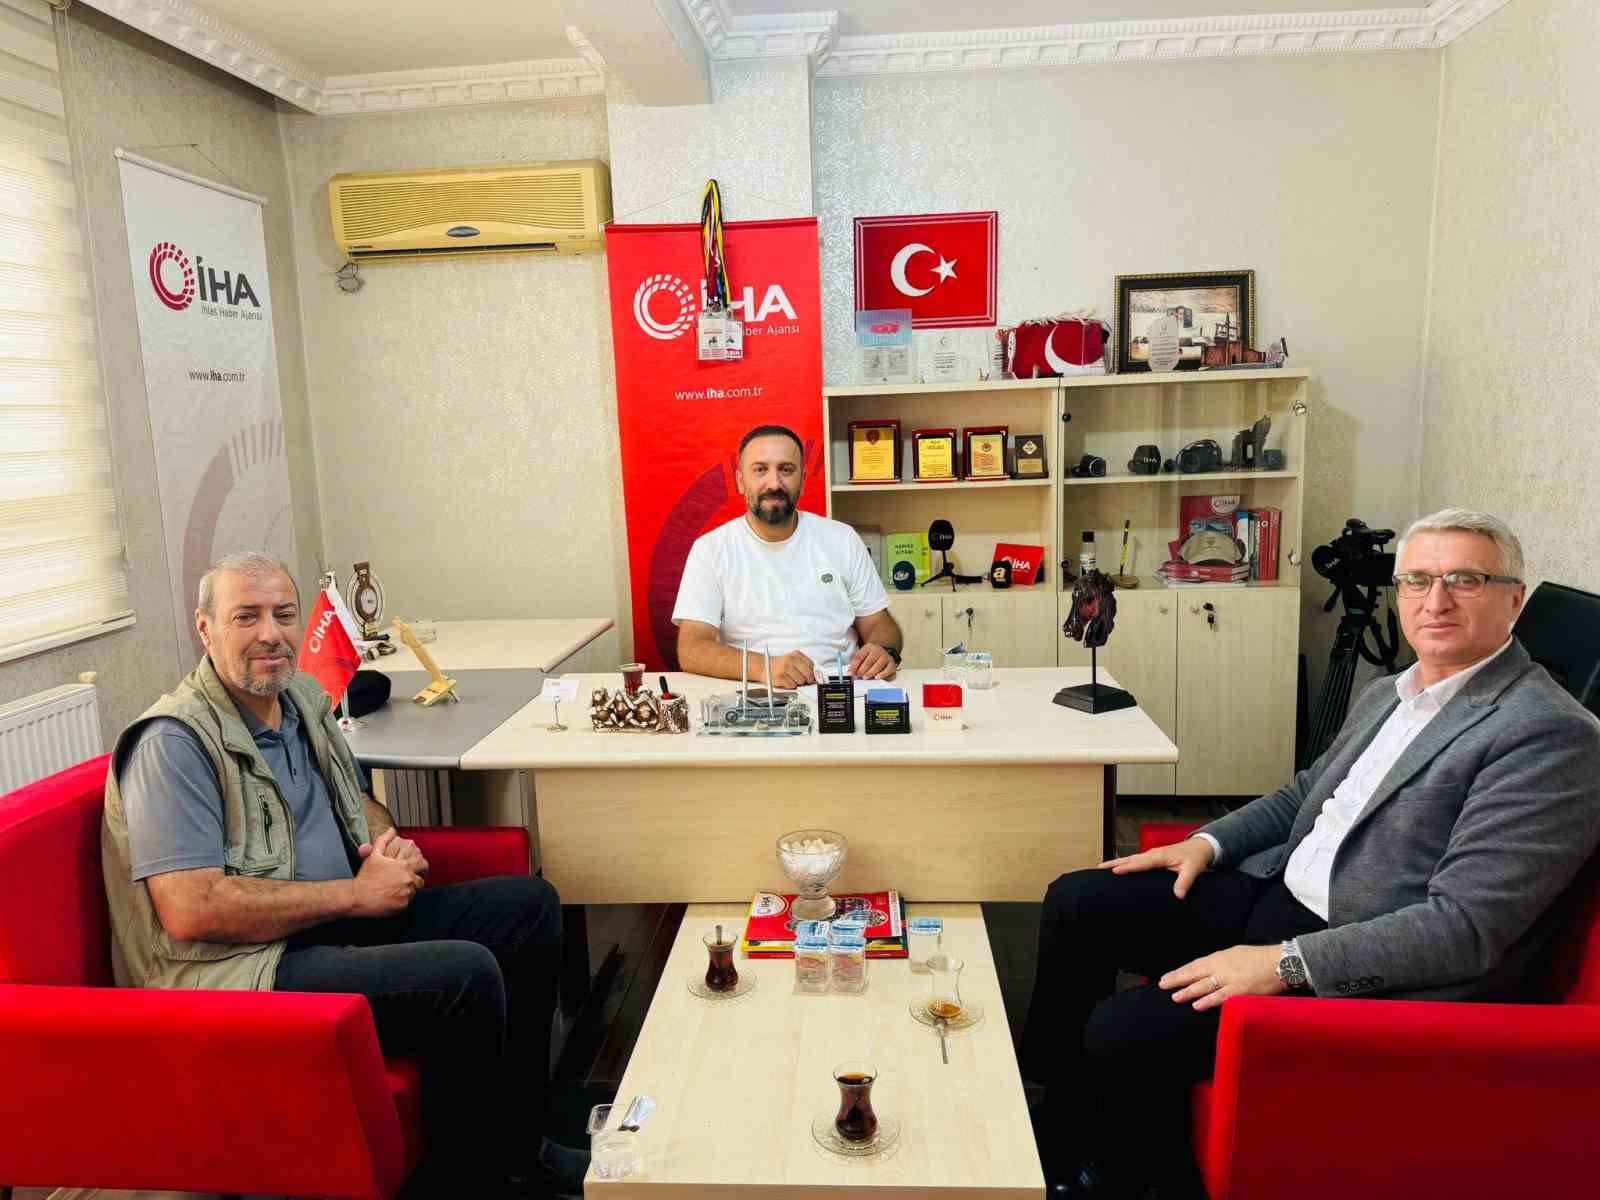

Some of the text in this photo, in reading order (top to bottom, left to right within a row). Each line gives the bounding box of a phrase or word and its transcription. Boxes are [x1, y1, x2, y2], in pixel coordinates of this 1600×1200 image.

[196, 255, 261, 307] İHA
[767, 325, 801, 337] Ajansı
[188, 369, 246, 382] www.iha.com.tr
[674, 386, 763, 400] www.iha.com.tr
